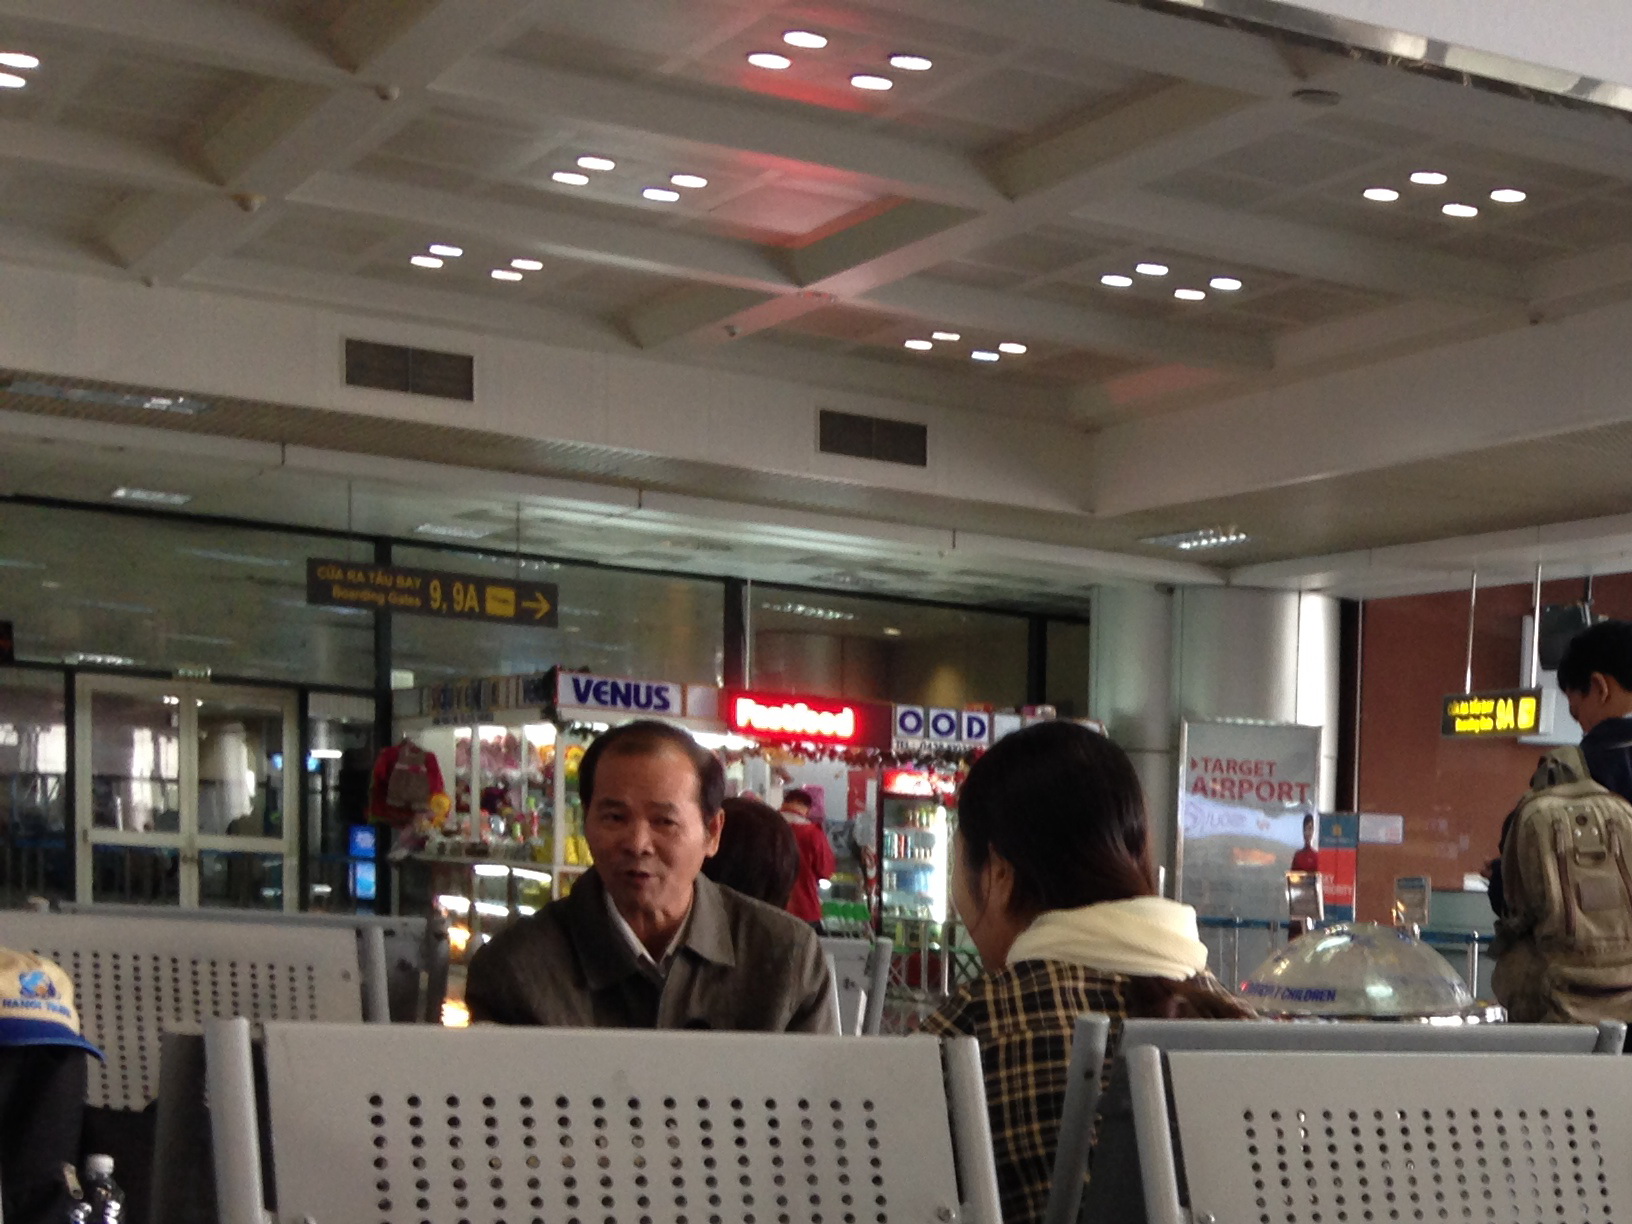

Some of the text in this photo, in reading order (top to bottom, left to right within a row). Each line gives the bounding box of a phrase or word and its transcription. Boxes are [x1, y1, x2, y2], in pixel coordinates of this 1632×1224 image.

[453, 582, 479, 612] 9A
[571, 677, 670, 711] VENUS
[1496, 697, 1515, 731] 9A
[1201, 756, 1277, 777] TARGET
[1192, 776, 1310, 803] AIRPORT
